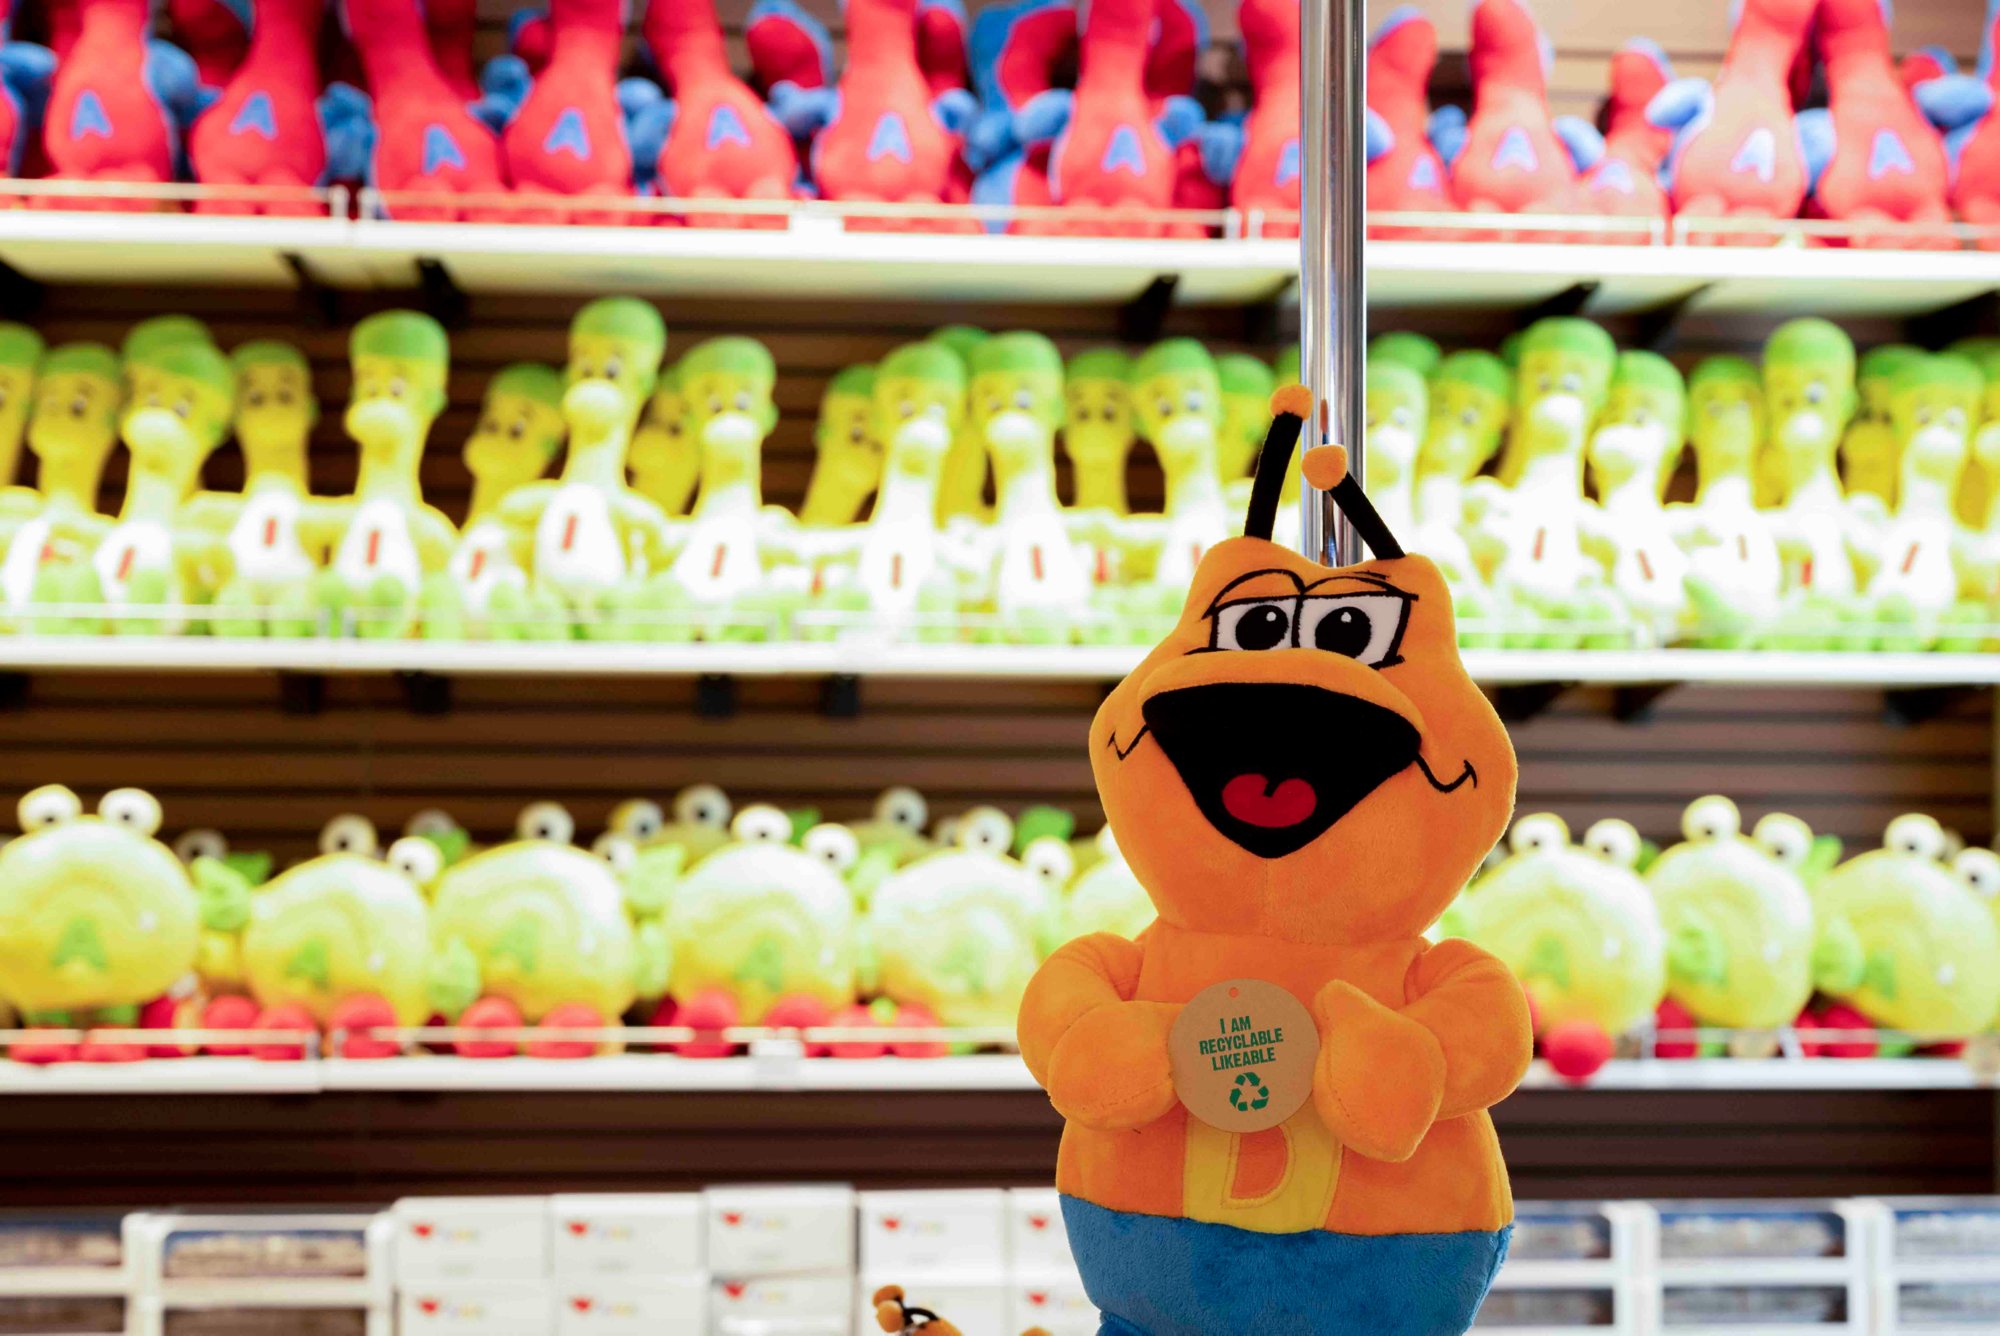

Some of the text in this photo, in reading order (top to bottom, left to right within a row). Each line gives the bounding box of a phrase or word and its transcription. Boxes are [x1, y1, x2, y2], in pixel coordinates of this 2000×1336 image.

[1220, 1016, 1251, 1034] I AM
[1199, 1027, 1284, 1055] RECYCLABLE
[1212, 1047, 1276, 1071] LIKEABLE
